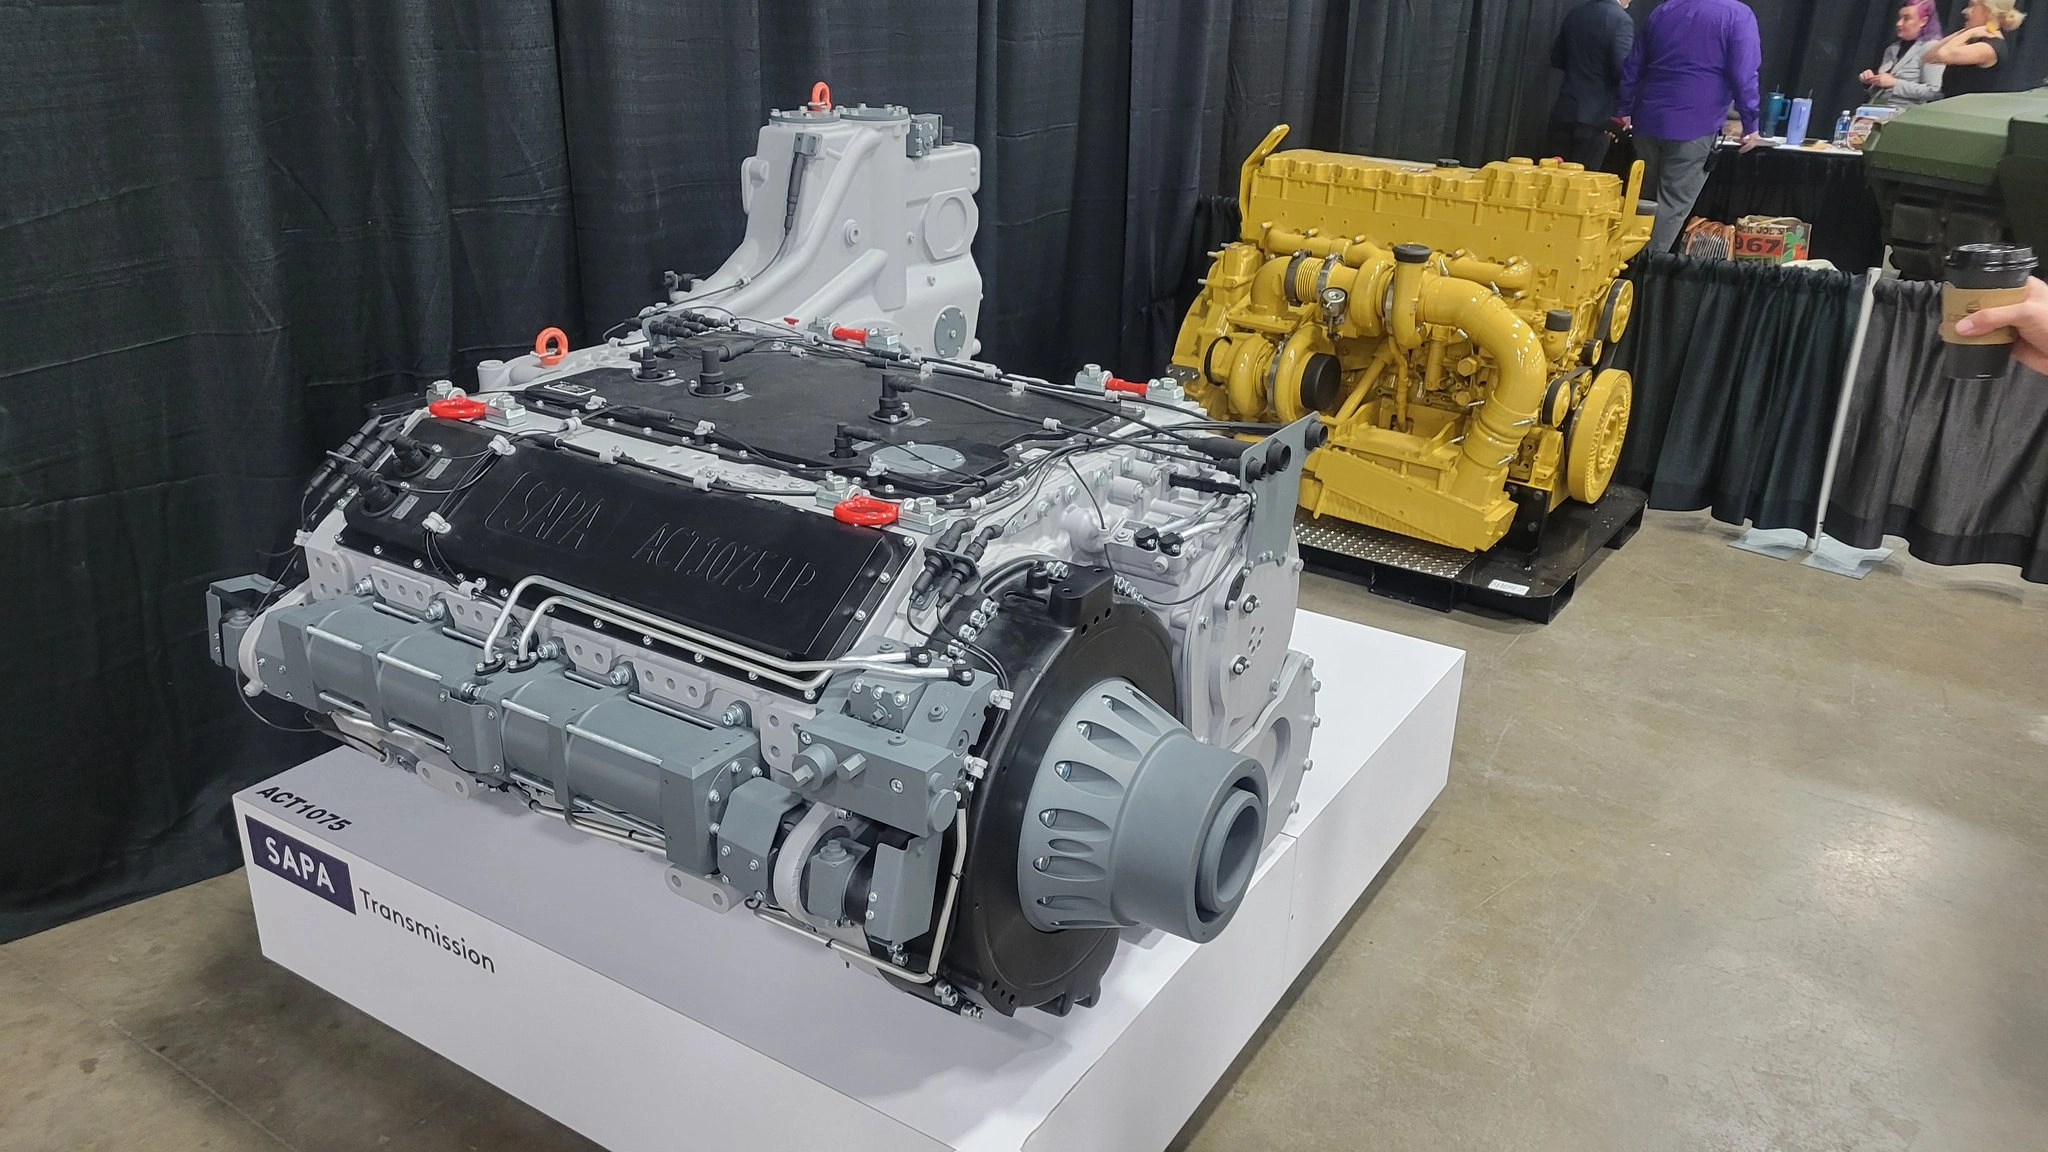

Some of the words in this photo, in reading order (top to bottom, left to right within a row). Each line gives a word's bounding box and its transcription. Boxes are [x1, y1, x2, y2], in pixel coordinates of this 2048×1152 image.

[1735, 235, 1781, 253] 967
[503, 480, 603, 550] SAPA
[256, 786, 352, 831] ACT1075
[265, 836, 335, 893] SAPA
[359, 887, 495, 973] Transmission
